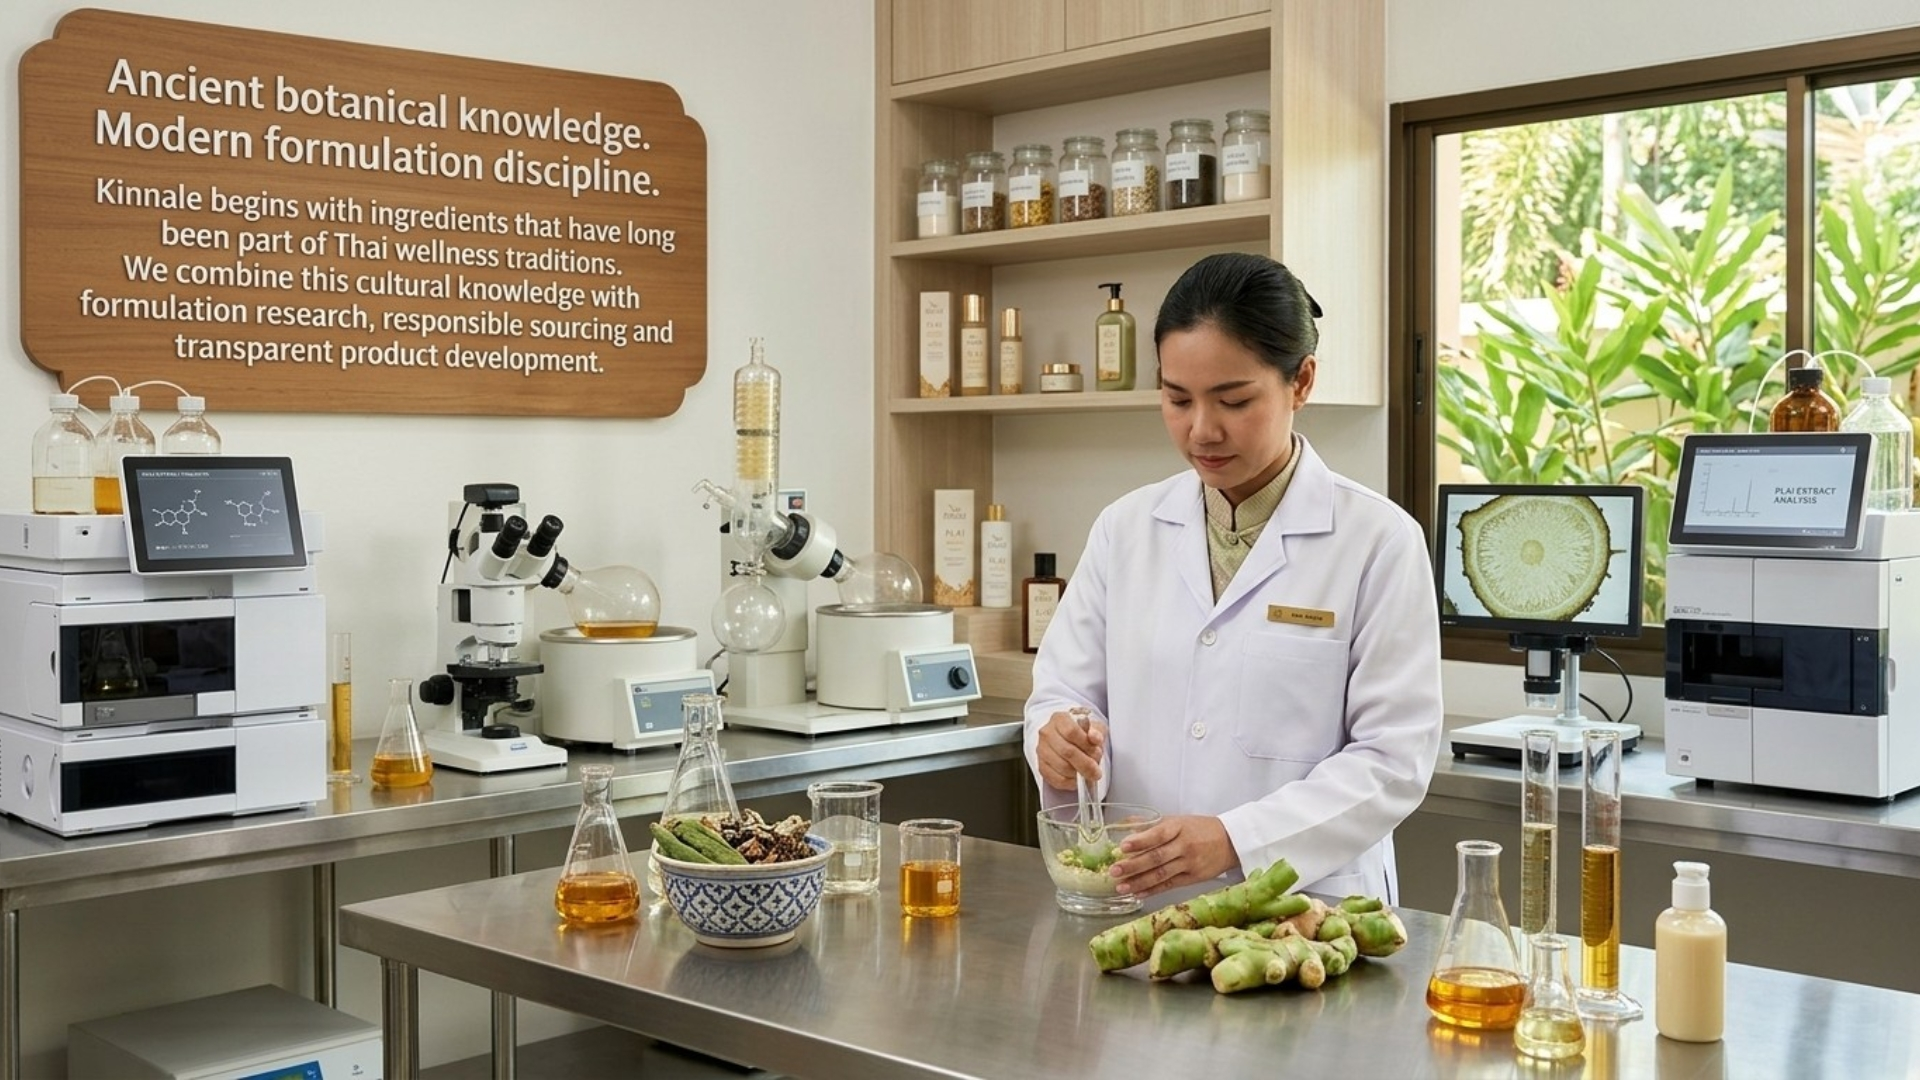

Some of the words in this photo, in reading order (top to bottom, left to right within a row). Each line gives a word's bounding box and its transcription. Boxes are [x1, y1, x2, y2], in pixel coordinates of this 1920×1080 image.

[107, 58, 265, 109] Ancient
[276, 75, 447, 129] botanical
[459, 96, 650, 155] knowledge.
[96, 109, 253, 158] Modern
[263, 124, 483, 180] formulation
[493, 149, 659, 198] discipline.
[97, 178, 203, 211] Kinnale
[211, 186, 299, 222] begins
[306, 196, 363, 223] with
[371, 200, 509, 236] ingredients
[514, 213, 561, 238] that
[569, 216, 621, 243] have
[628, 220, 675, 253] long
[162, 219, 229, 249] been
[238, 230, 293, 257] part
[300, 229, 330, 256] of
[333, 231, 388, 260] Thai
[395, 239, 499, 267] wellness
[505, 247, 622, 275] traditions.
[123, 255, 168, 282] We
[176, 260, 294, 290] combine
[301, 265, 349, 292] this
[356, 271, 450, 298] cultural
[458, 275, 585, 311] knowledge
[591, 284, 640, 309] with
[80, 289, 247, 324] formulation
[256, 304, 374, 333] research,
[383, 310, 523, 339] responsible
[530, 318, 627, 347] sourcing
[633, 318, 673, 343] and
[174, 334, 333, 366] transparent
[341, 341, 439, 369] product
[445, 344, 604, 376] development.
[1773, 496, 1818, 504] ANALYSIS
[1774, 487, 1795, 495] PLAI
